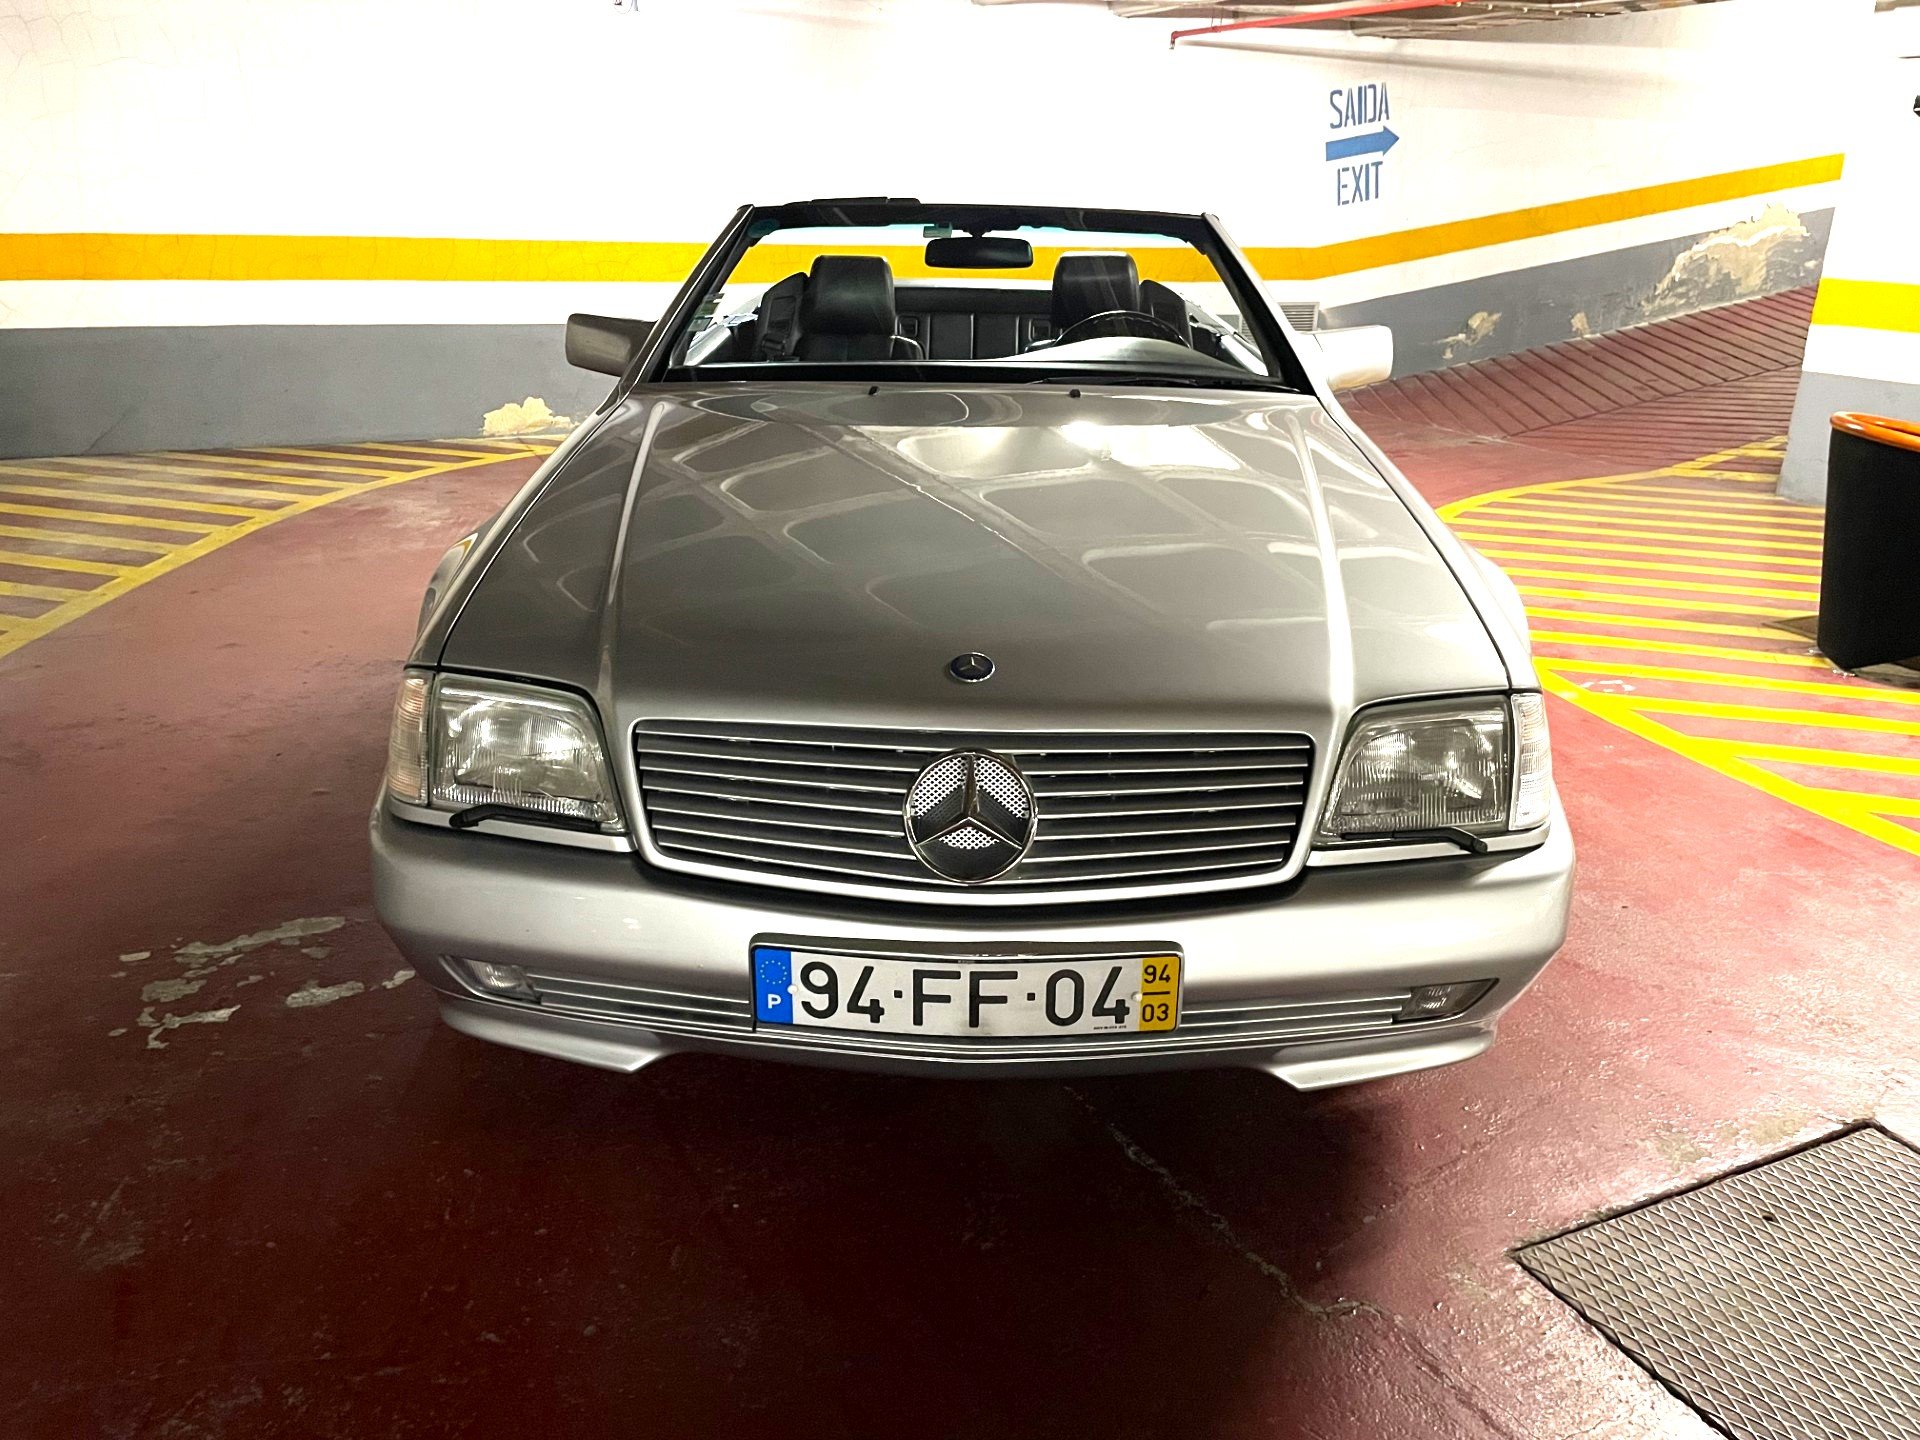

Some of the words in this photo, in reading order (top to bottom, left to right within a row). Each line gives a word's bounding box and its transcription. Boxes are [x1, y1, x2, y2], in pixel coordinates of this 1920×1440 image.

[1330, 82, 1389, 129] SAIDA
[1337, 161, 1383, 206] EXIT
[1143, 965, 1171, 984] 94
[767, 993, 782, 1009] P
[1141, 1002, 1170, 1023] 03
